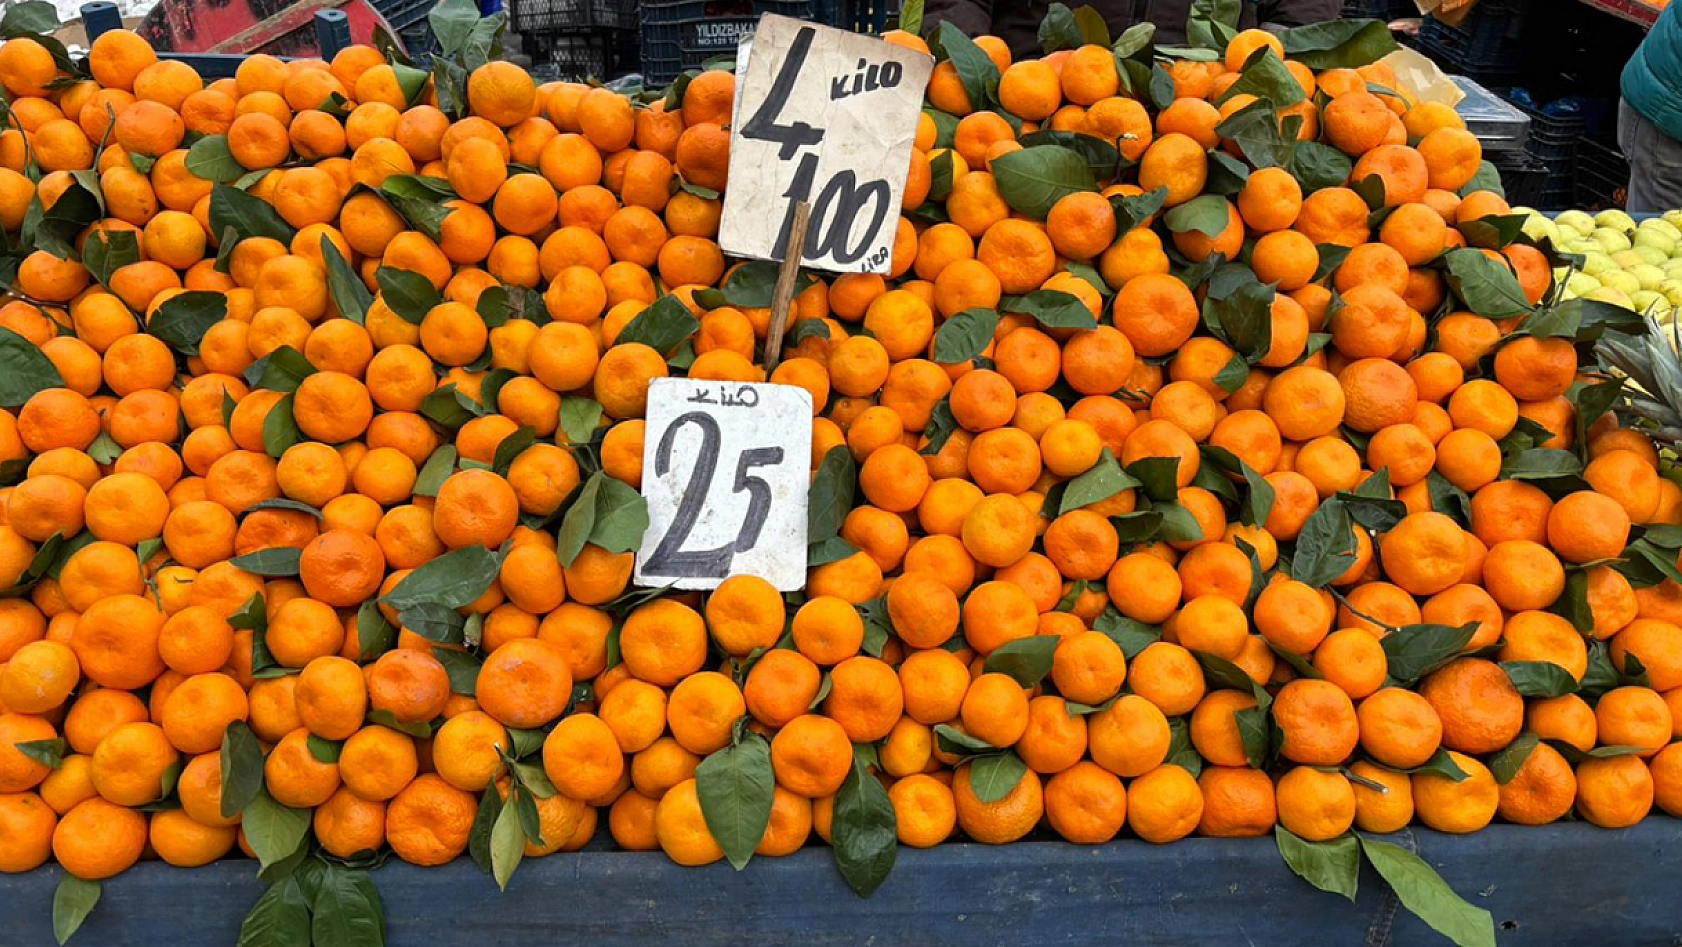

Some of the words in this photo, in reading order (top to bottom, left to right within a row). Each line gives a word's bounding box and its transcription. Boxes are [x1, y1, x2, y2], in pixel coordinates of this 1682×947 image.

[739, 26, 826, 161] 4
[770, 152, 892, 265] 100
[640, 410, 785, 578] 25
